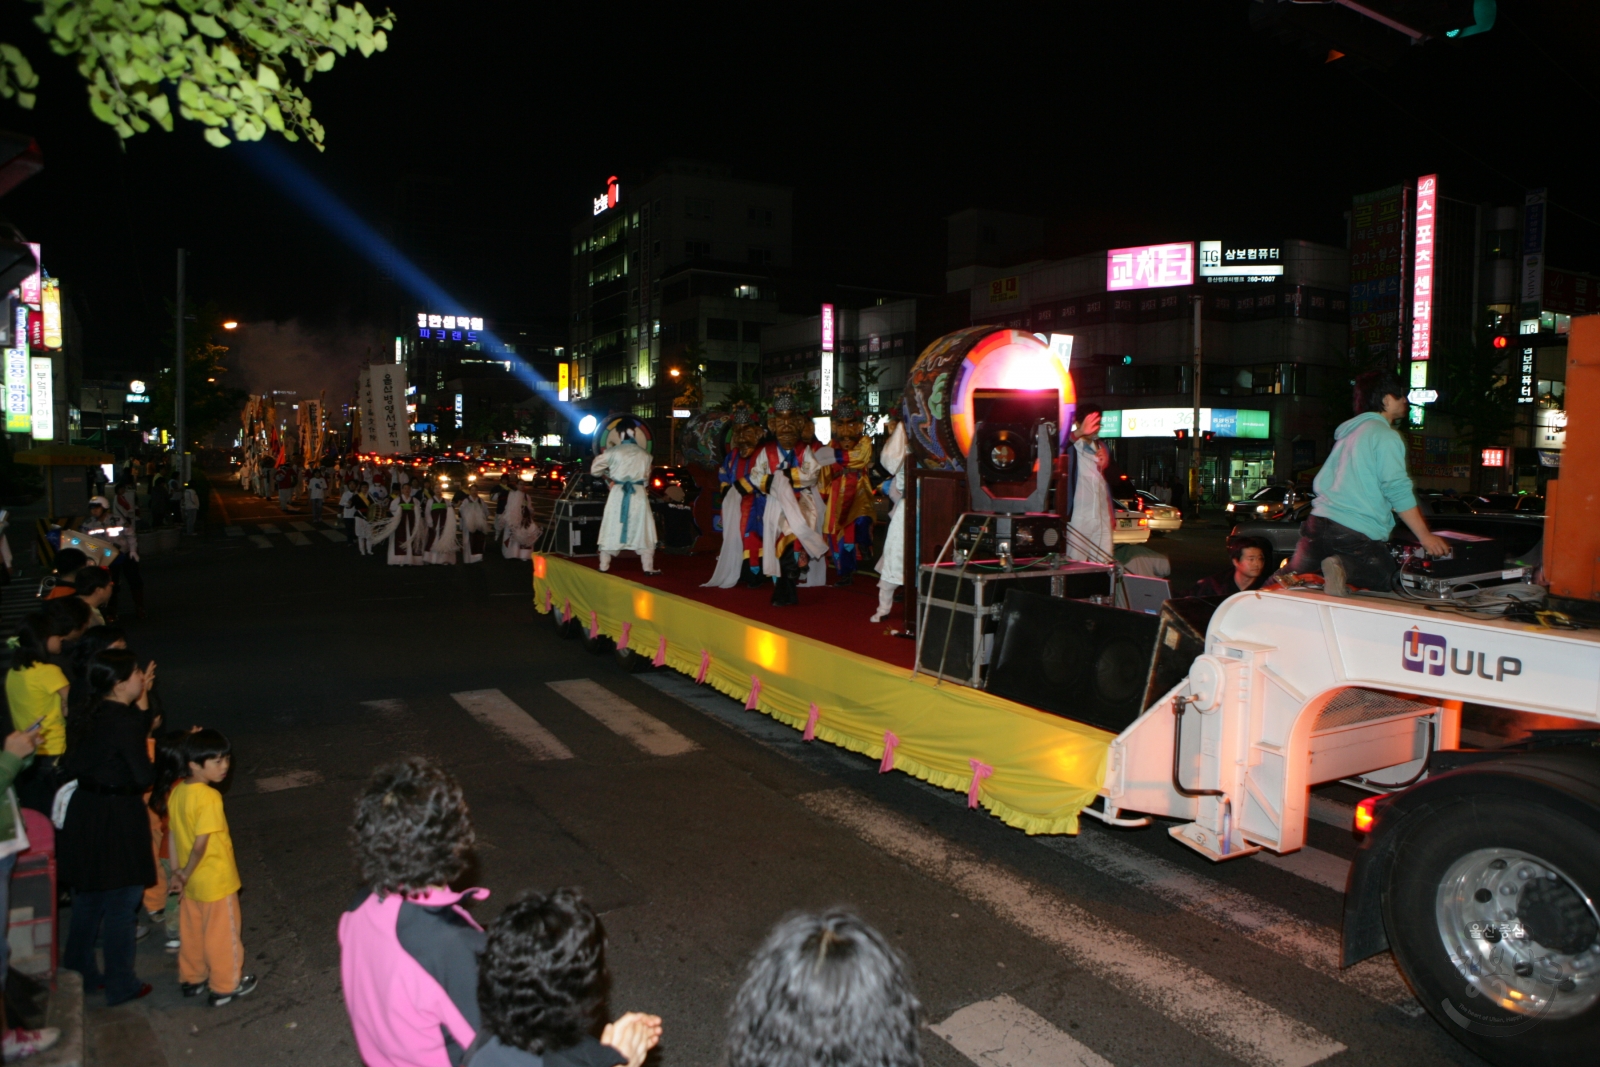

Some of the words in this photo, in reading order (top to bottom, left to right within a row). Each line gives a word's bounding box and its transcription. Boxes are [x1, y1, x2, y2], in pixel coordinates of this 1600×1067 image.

[1355, 197, 1399, 229] 골프
[1354, 221, 1399, 241] (레슨무료)
[1110, 243, 1192, 288] 교차로
[1202, 250, 1218, 262] TG
[1225, 248, 1279, 260] 삼보컴퓨터
[1414, 200, 1432, 320] 스포츠센타
[419, 329, 477, 341] 파크랜드
[824, 308, 832, 340] 교차로
[1523, 324, 1535, 334] TG
[1450, 647, 1522, 682] ULP
